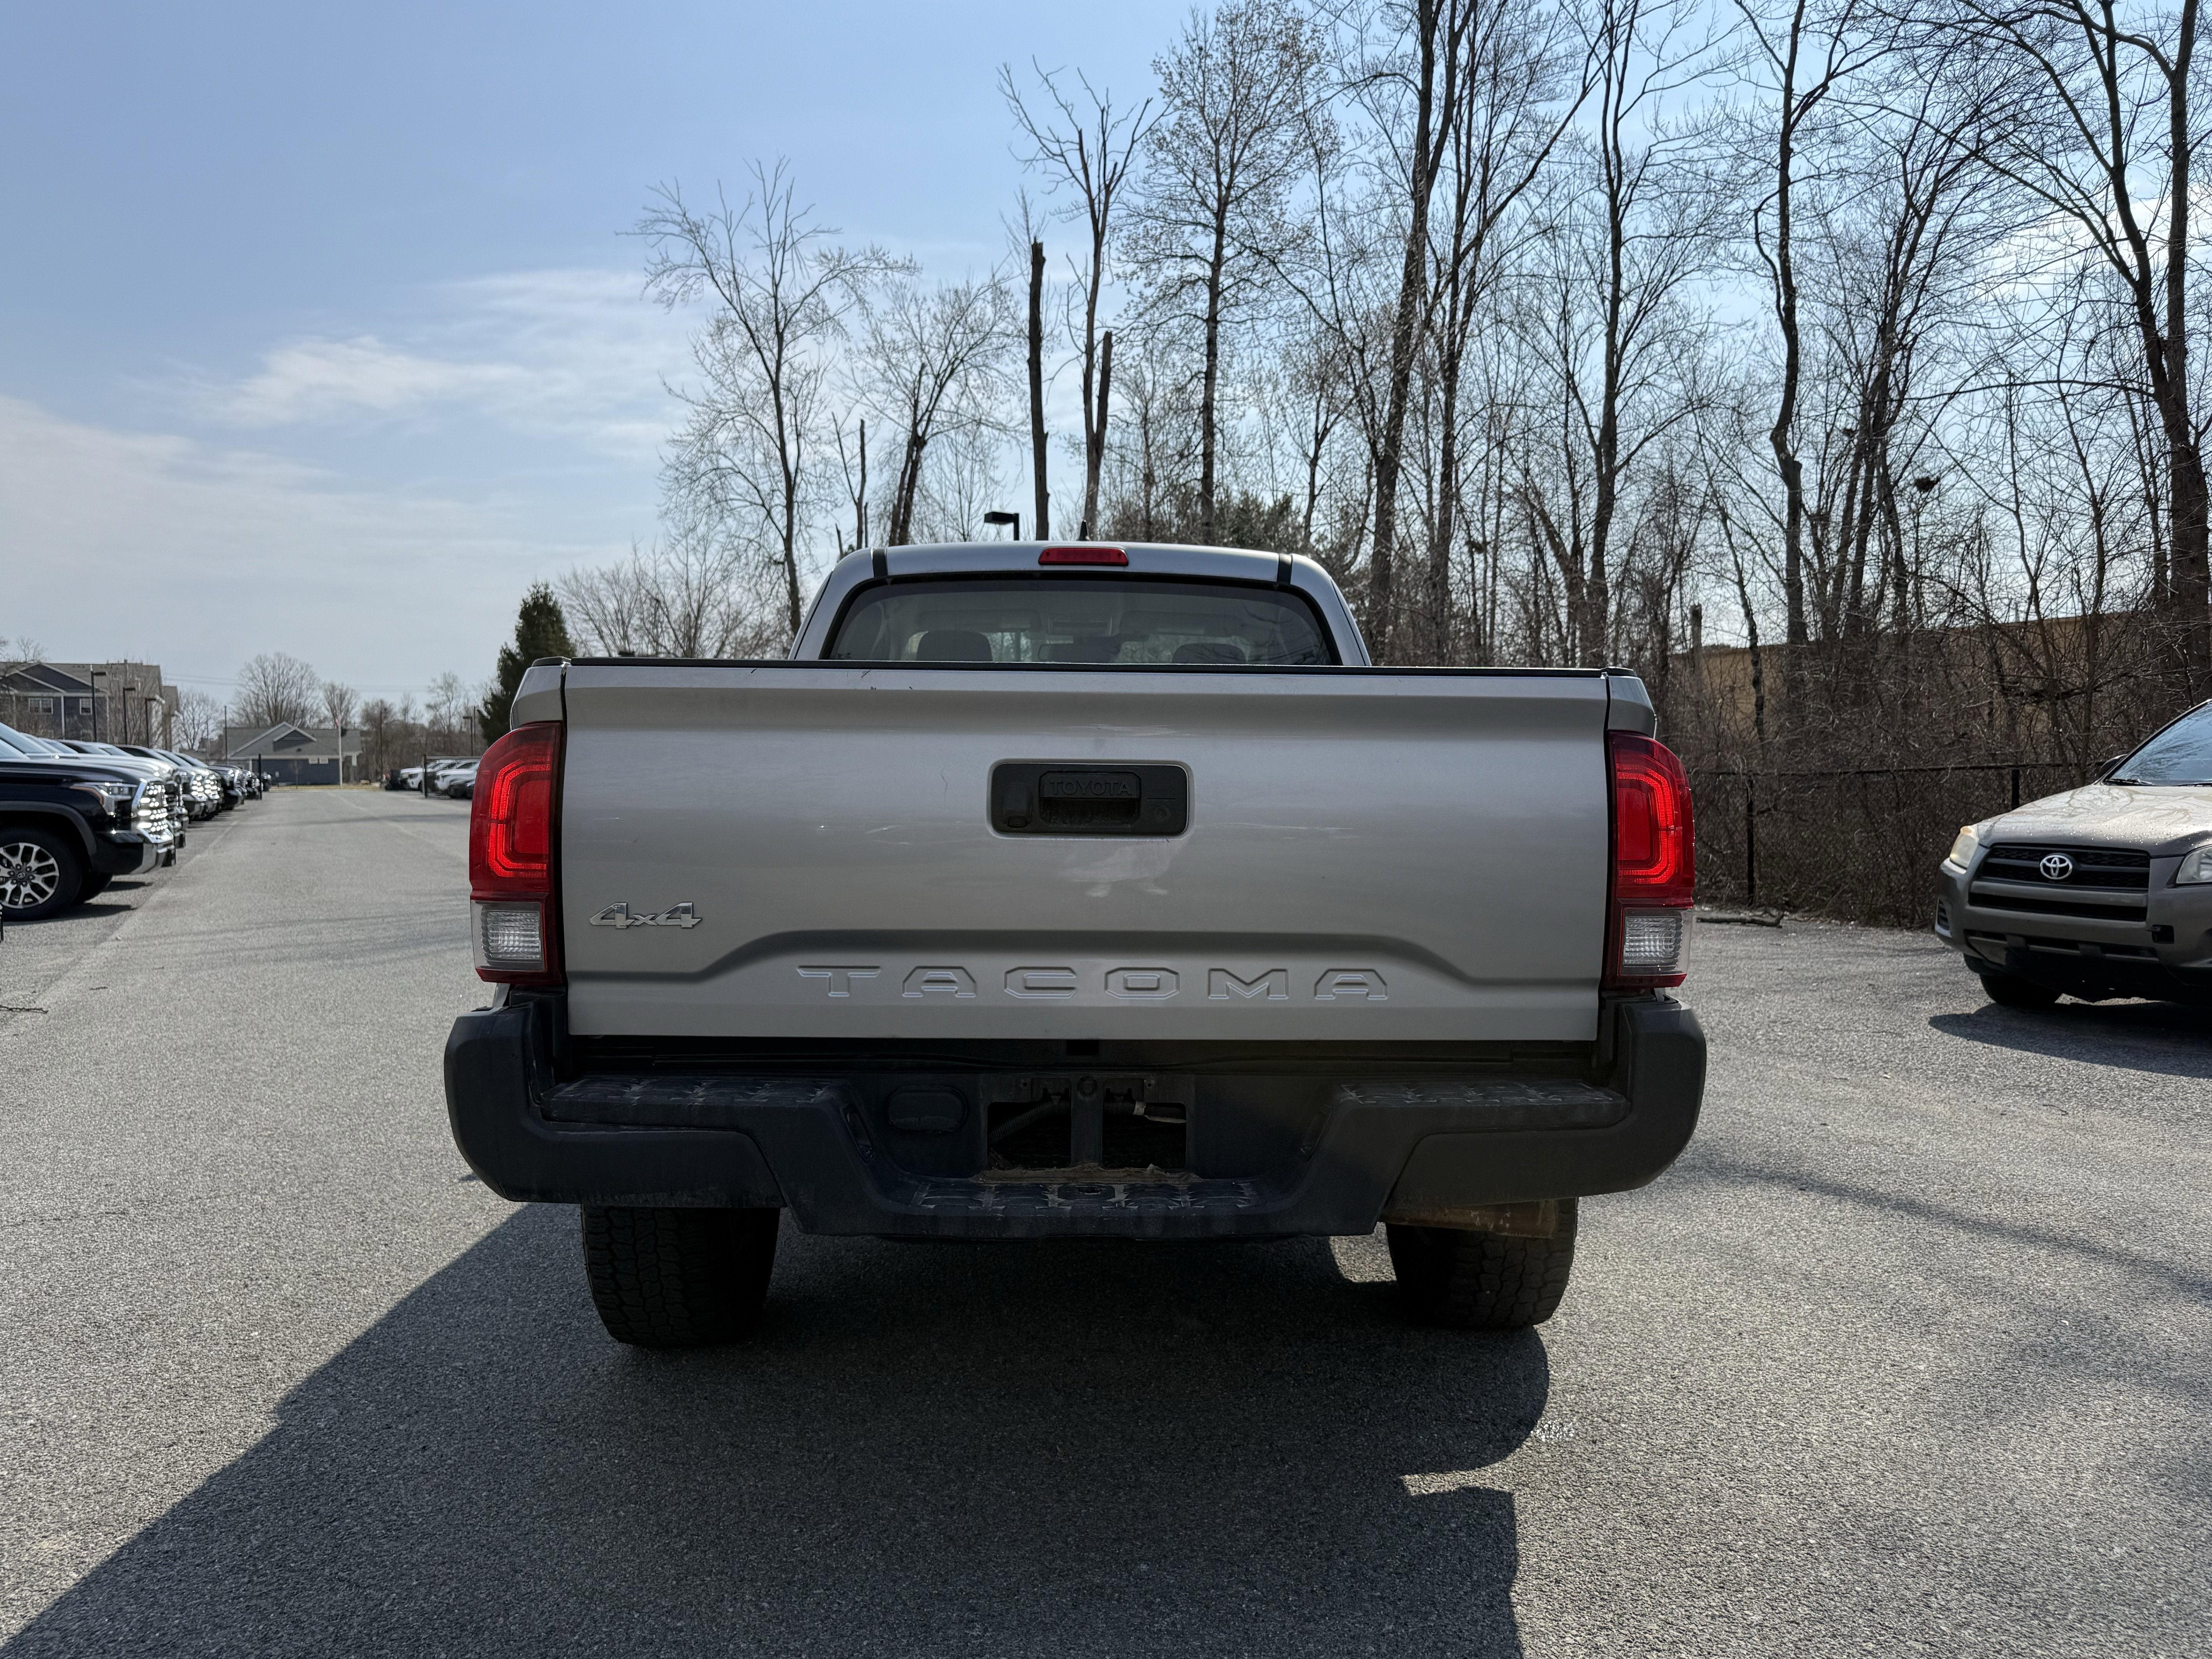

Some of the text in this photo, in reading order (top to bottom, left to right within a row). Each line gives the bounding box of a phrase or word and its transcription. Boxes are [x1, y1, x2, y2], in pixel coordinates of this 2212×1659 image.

[1049, 780, 1133, 796] TOYOTA
[589, 902, 702, 929] 4x4
[797, 965, 1388, 1000] TACOMA
